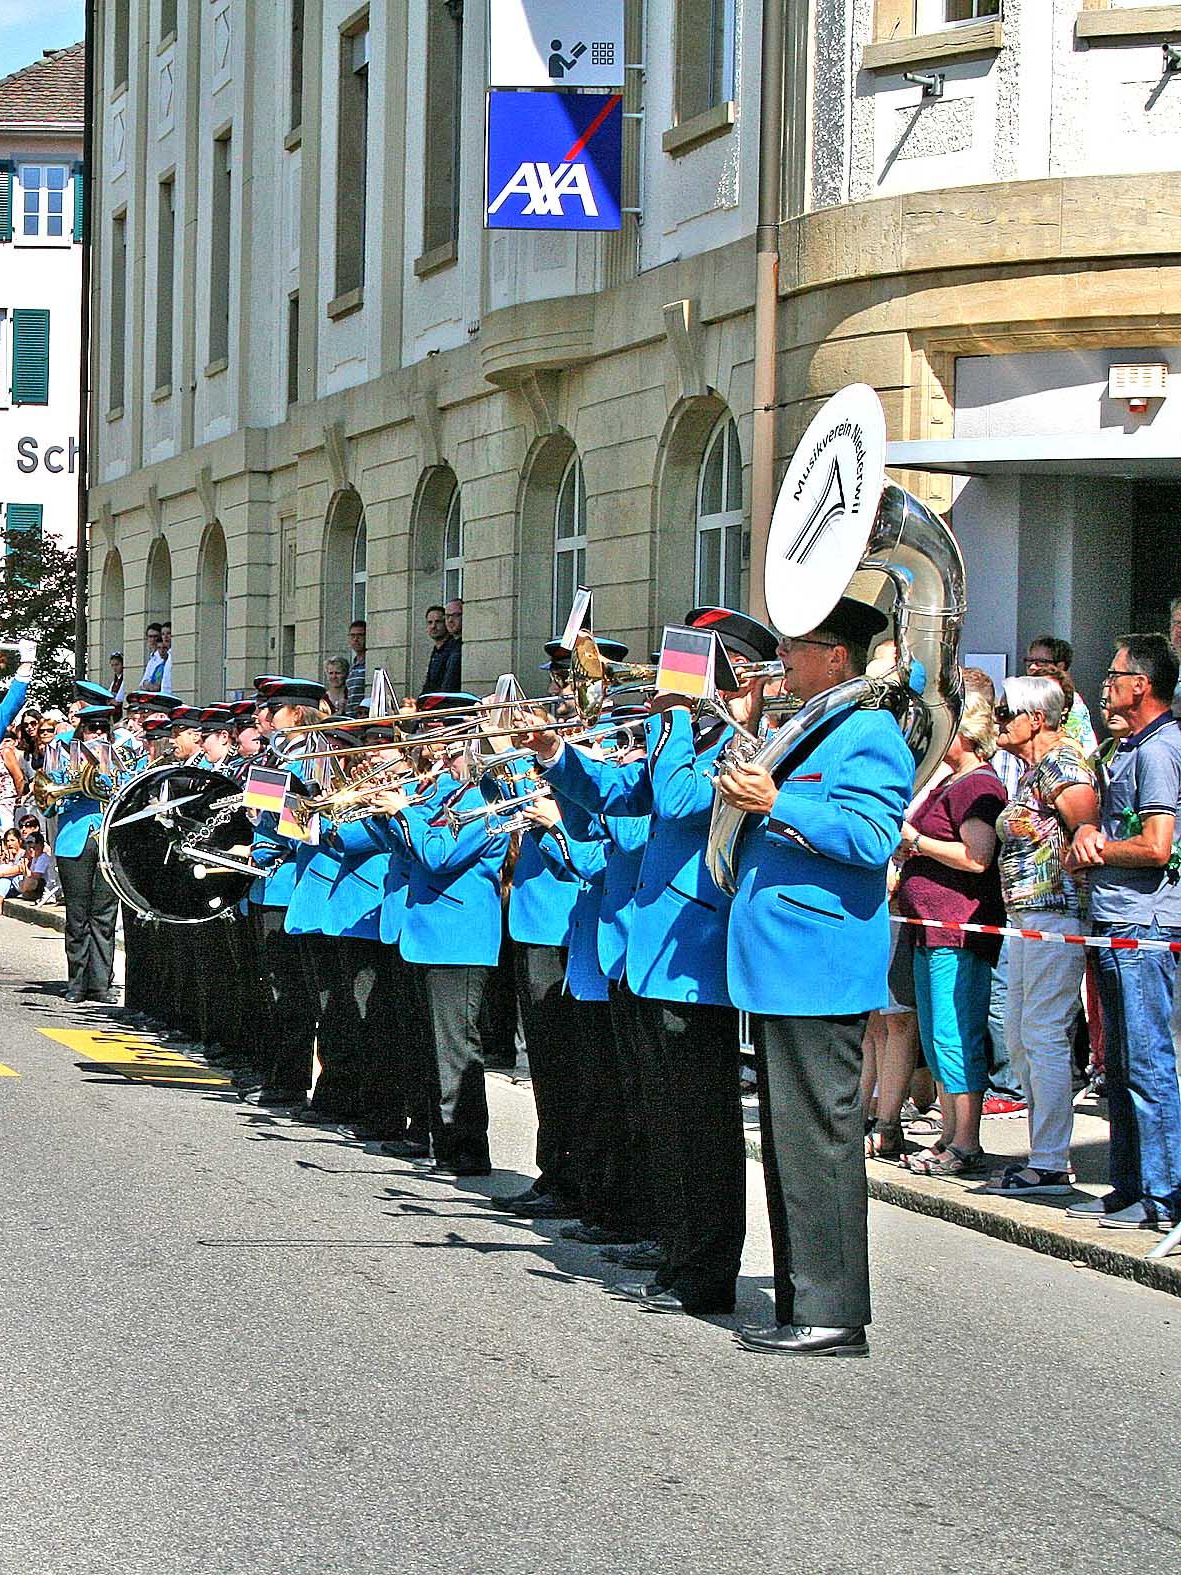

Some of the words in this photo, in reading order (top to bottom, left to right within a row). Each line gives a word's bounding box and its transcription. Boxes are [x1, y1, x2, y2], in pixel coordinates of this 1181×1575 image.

[488, 162, 599, 216] AXA
[793, 418, 852, 500] Musikverein
[850, 423, 867, 514] Niederwil
